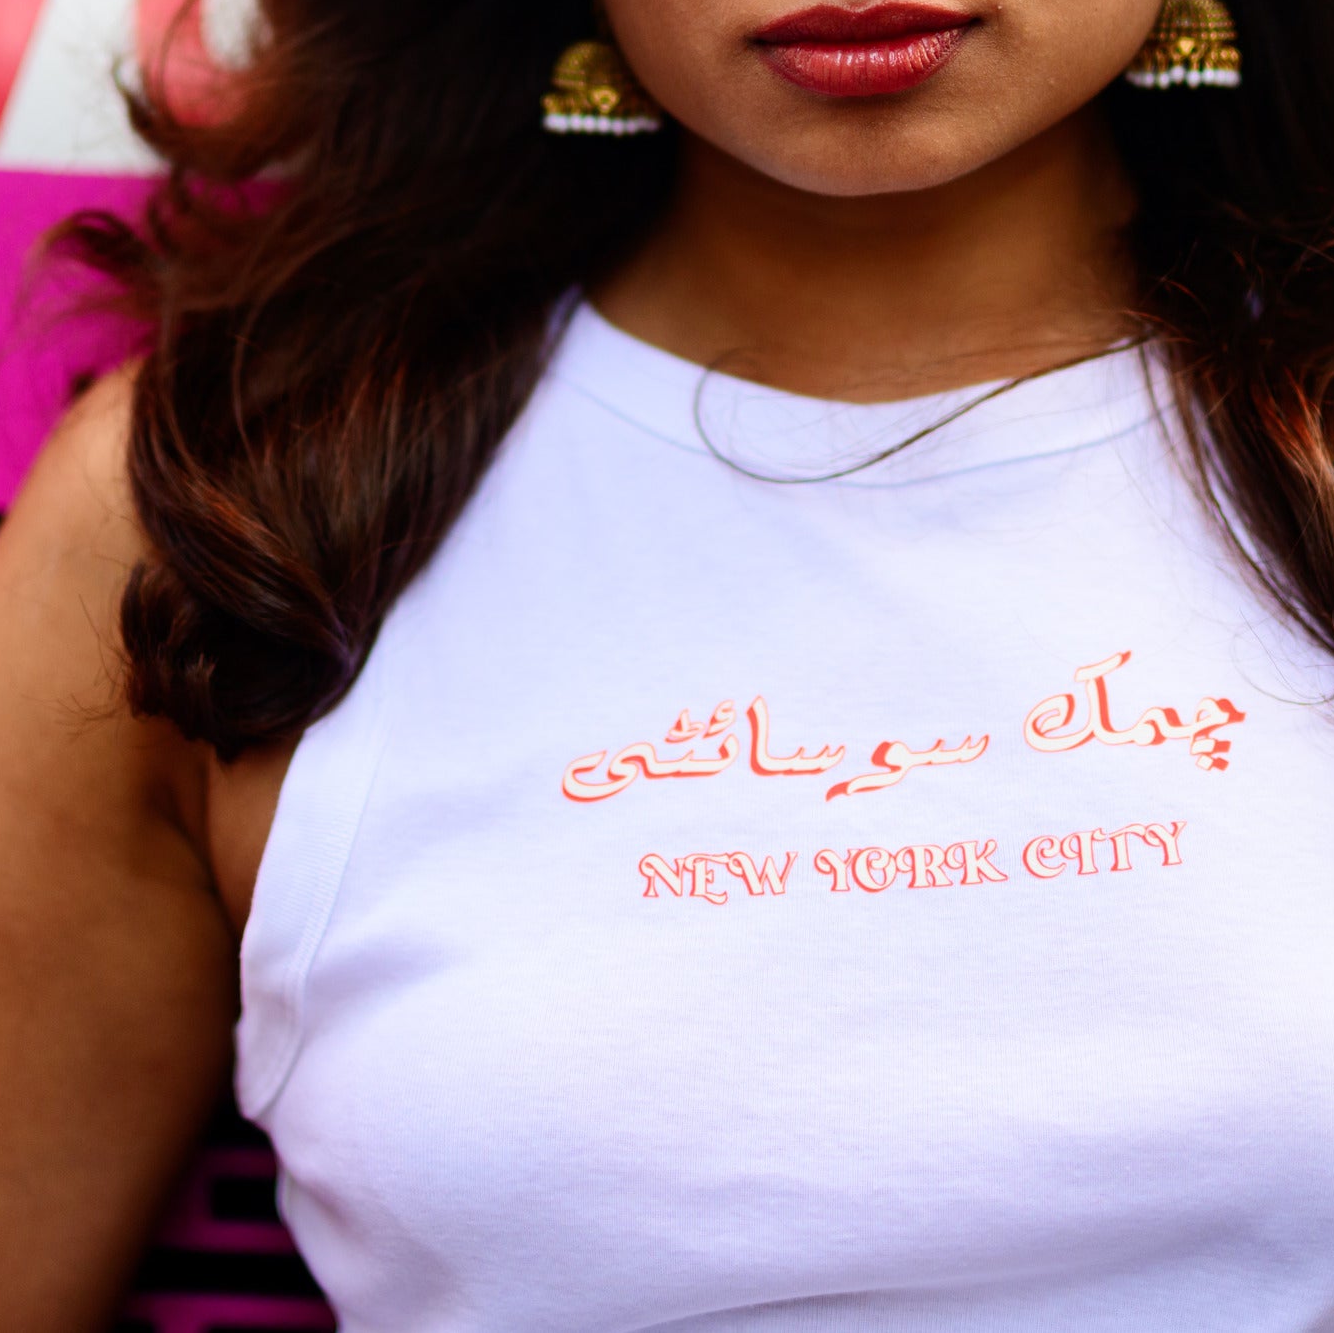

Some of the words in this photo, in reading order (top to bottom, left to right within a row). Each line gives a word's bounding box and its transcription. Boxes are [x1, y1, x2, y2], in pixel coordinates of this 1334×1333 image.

[637, 850, 800, 907] NEW
[812, 838, 1010, 895] YORK
[1020, 820, 1188, 881] CITY
